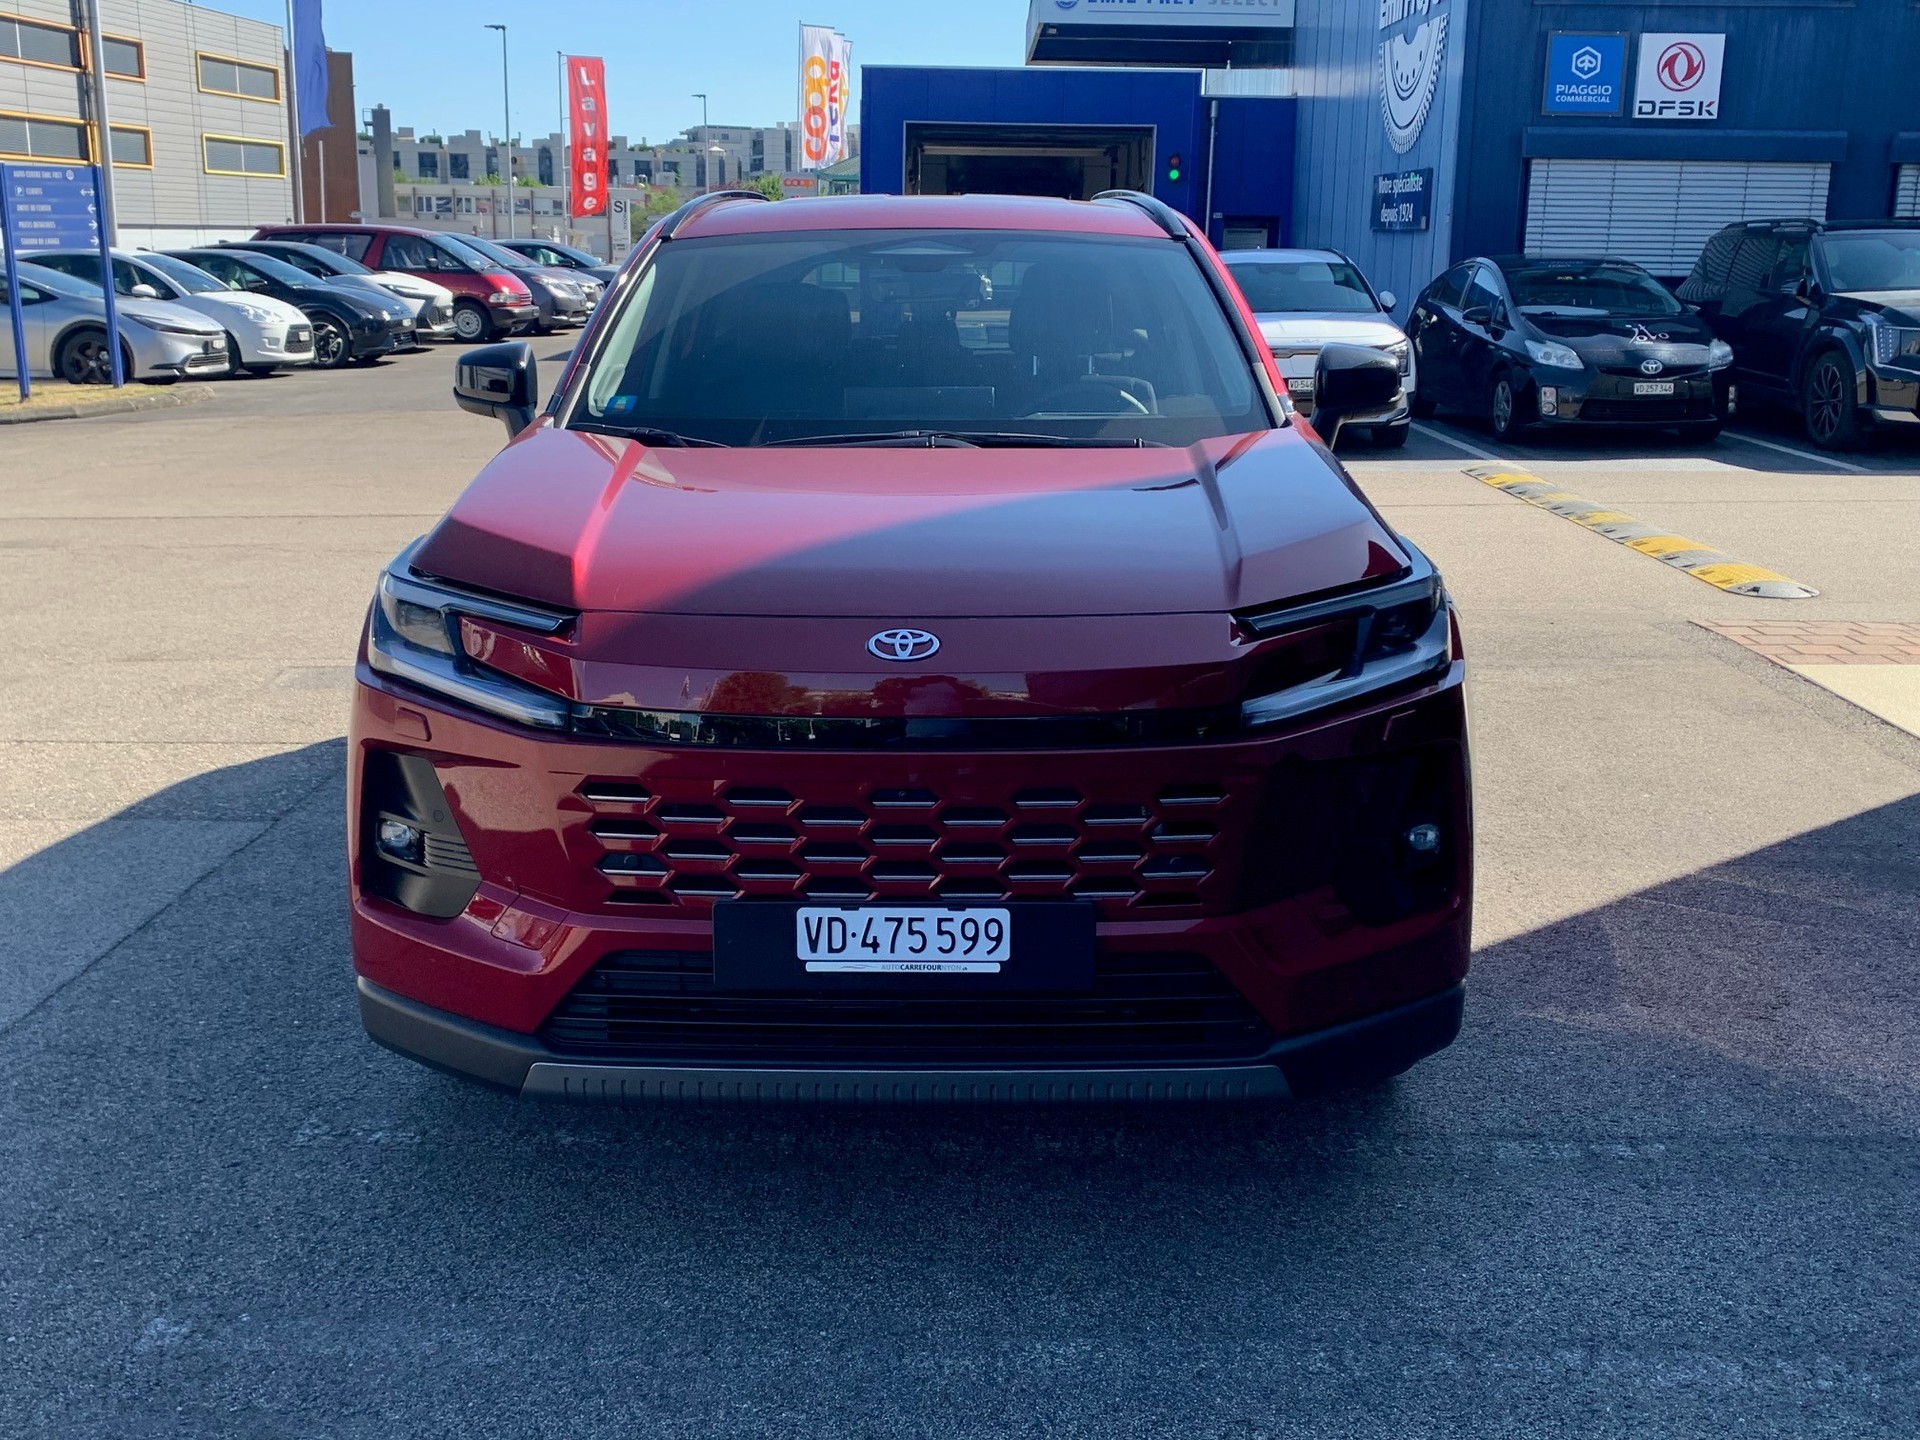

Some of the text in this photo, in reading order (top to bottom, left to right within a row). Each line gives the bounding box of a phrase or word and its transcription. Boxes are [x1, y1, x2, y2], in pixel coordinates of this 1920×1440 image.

[1556, 84, 1612, 95] PIAGGIO
[804, 55, 830, 161] coop
[1555, 95, 1611, 104] COMMERCIAL
[1637, 100, 1717, 117] DFSK
[580, 67, 597, 210] Lavage
[1399, 203, 1414, 222] 1924
